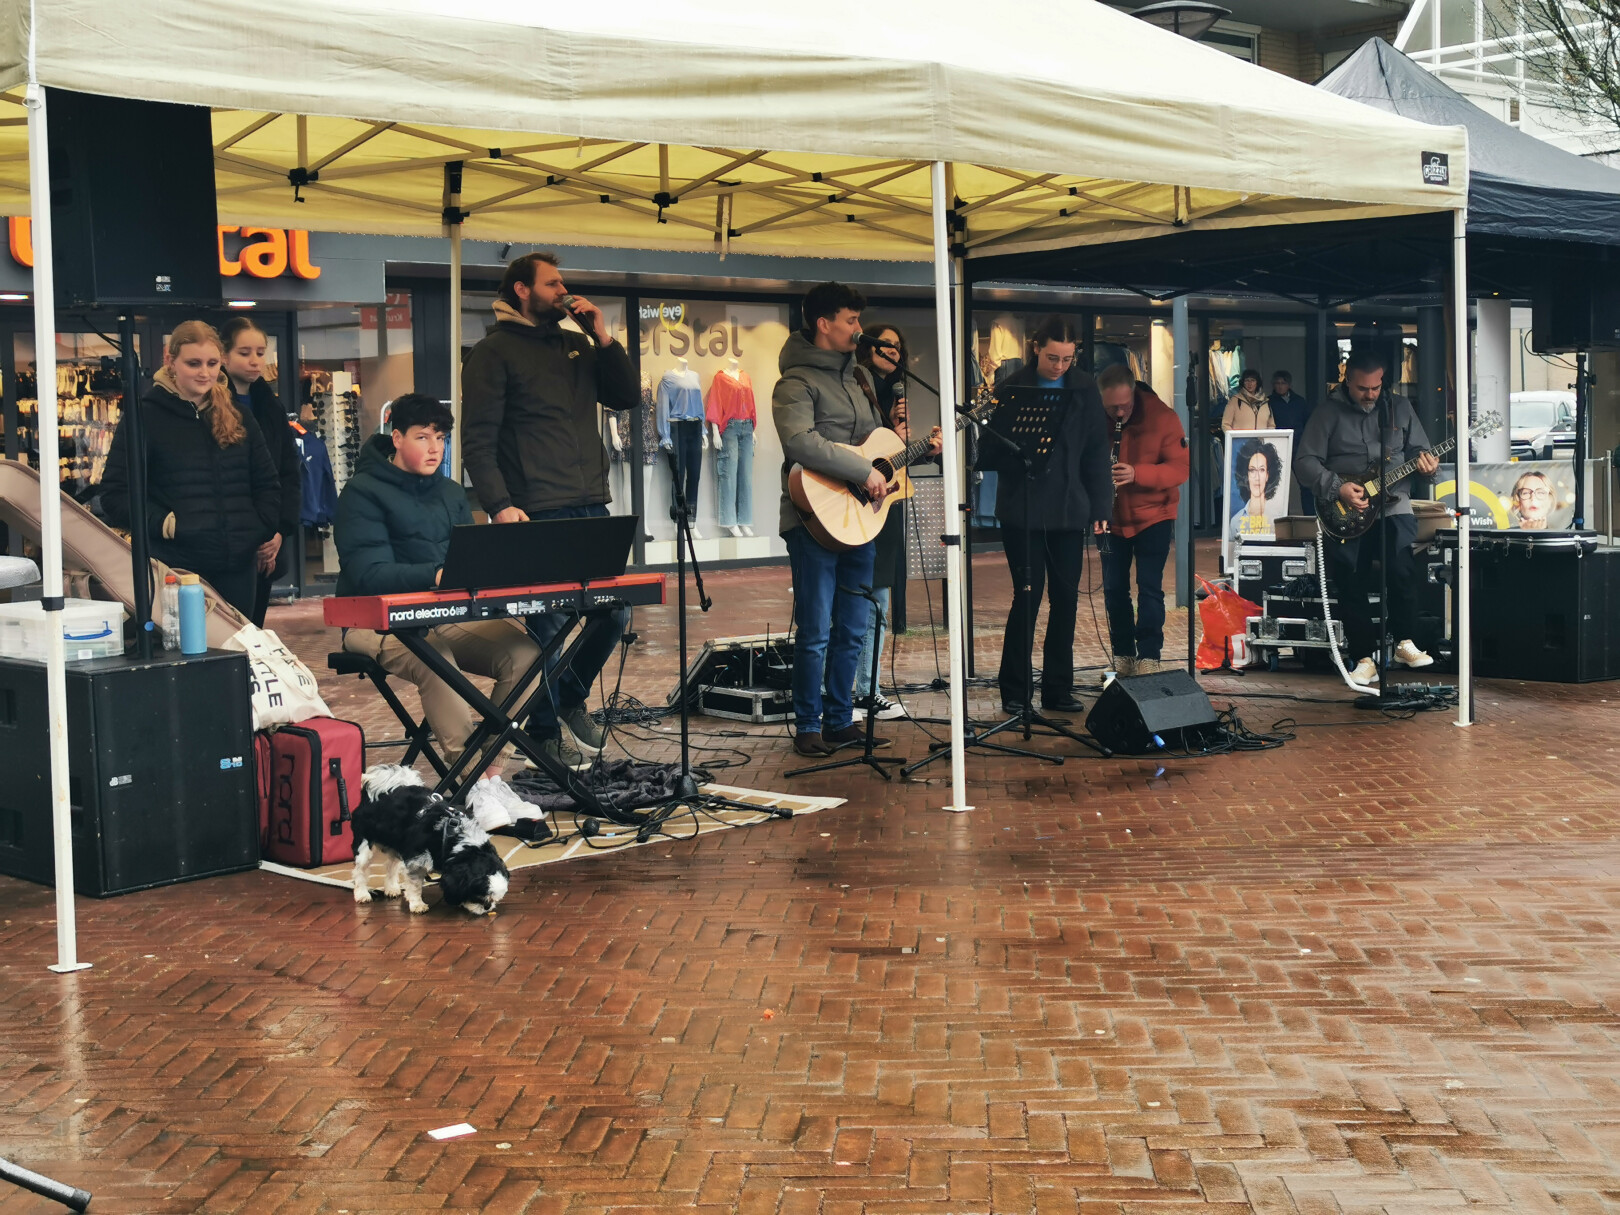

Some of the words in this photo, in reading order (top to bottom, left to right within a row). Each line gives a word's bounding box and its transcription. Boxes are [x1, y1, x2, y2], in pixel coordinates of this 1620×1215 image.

[1423, 165, 1447, 179] GRIZZLY
[1249, 515, 1271, 529] BRIL
[1470, 516, 1493, 525] Wish
[390, 609, 415, 621] nord
[415, 606, 449, 619] electro
[278, 754, 295, 846] nord
